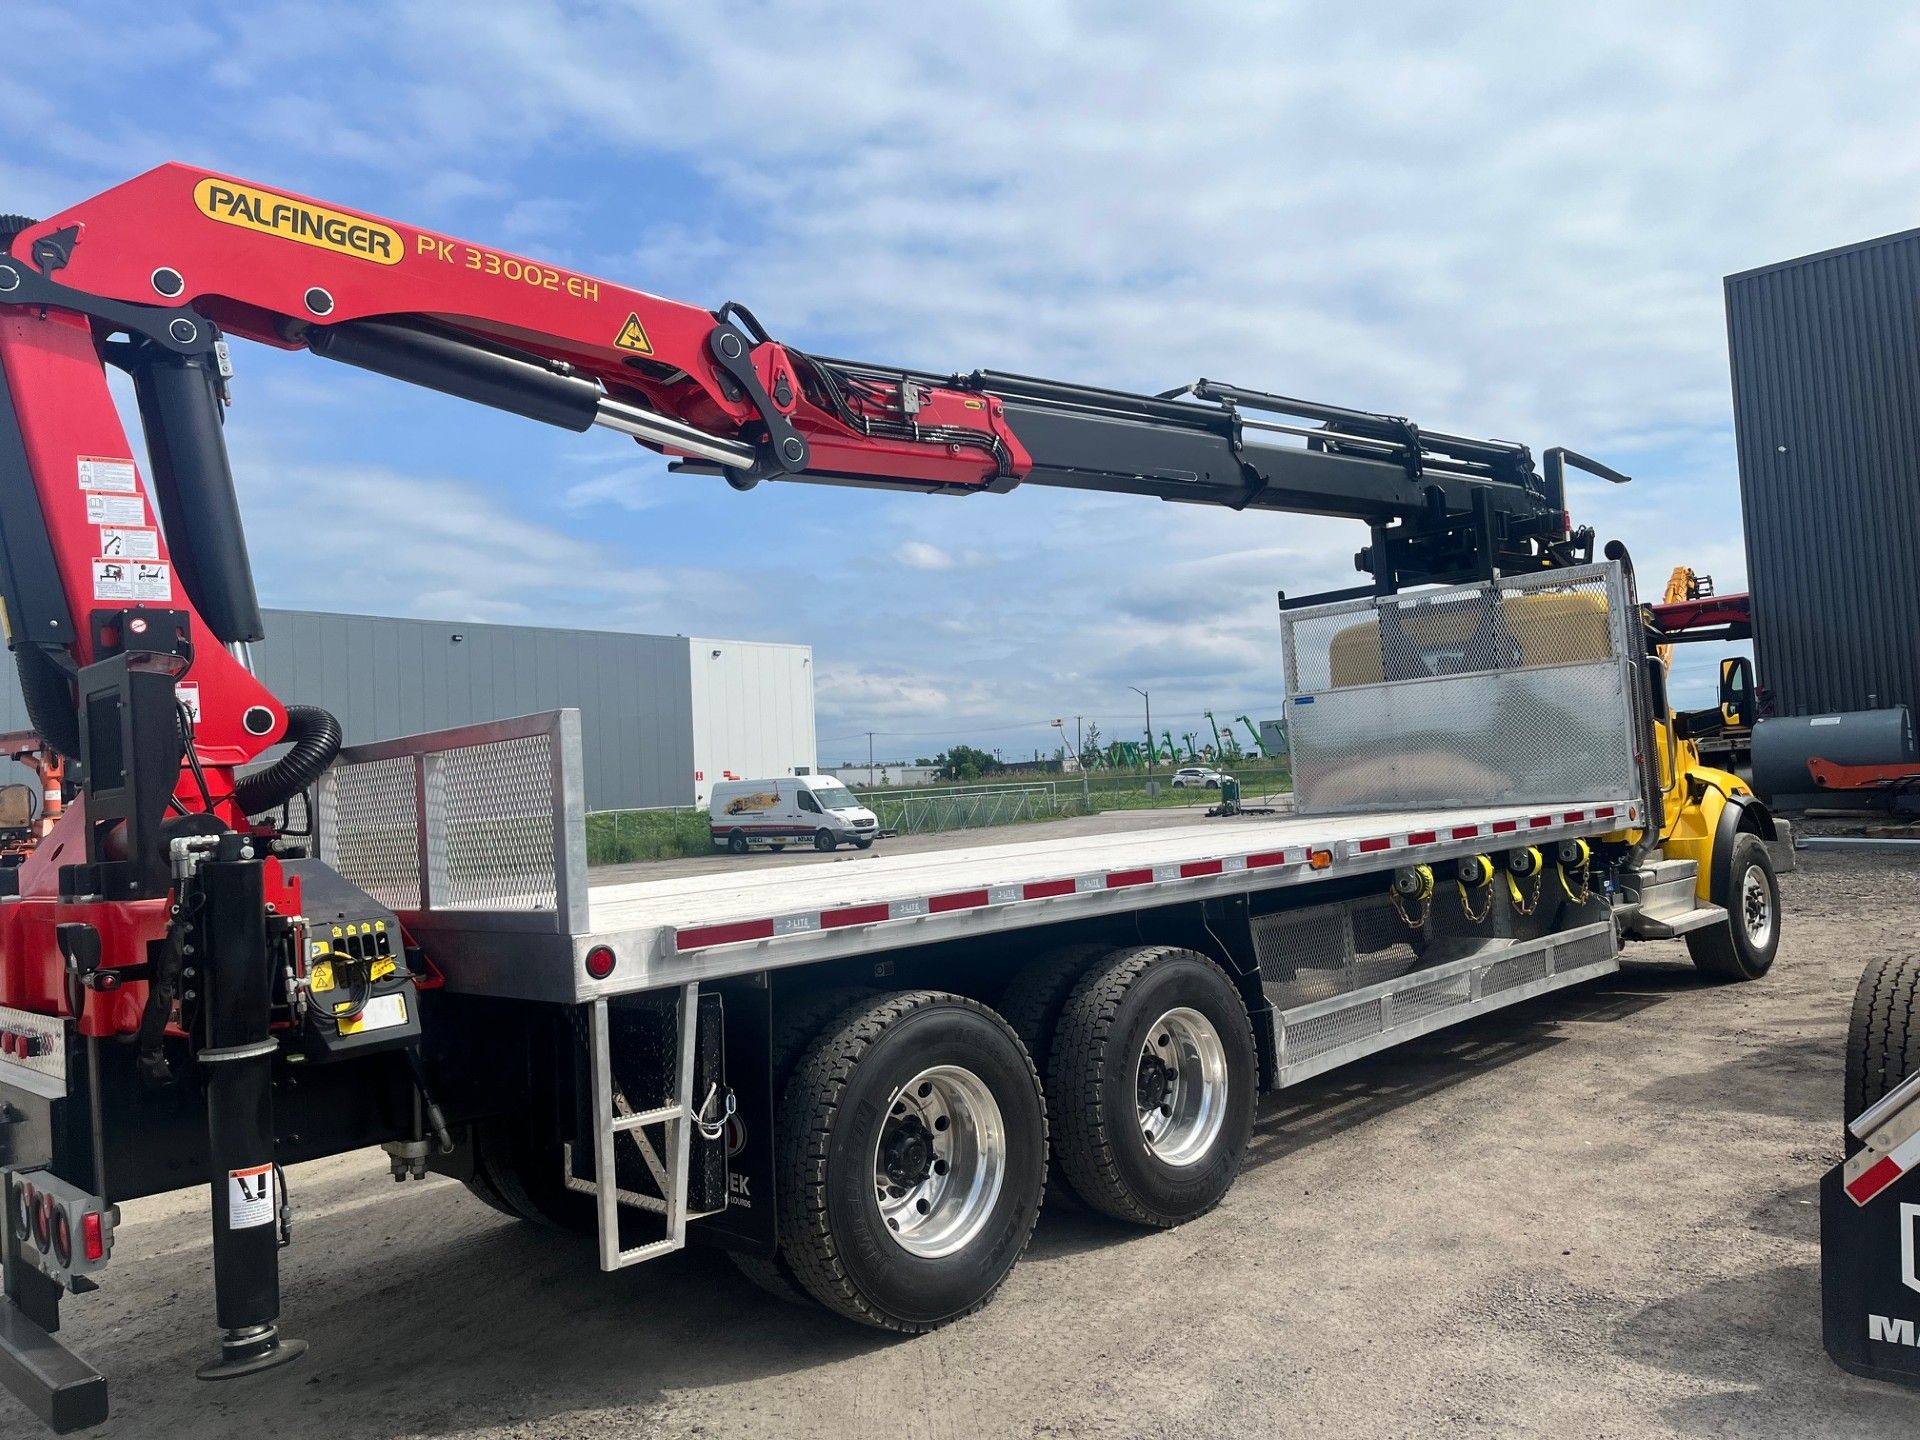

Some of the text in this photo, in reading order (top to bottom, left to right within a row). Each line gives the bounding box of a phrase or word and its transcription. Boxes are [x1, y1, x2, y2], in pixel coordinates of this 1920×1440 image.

[209, 186, 391, 258] PALFINGER
[417, 234, 456, 265] PK
[786, 918, 809, 928] J-LITE
[730, 1172, 750, 1196] EK
